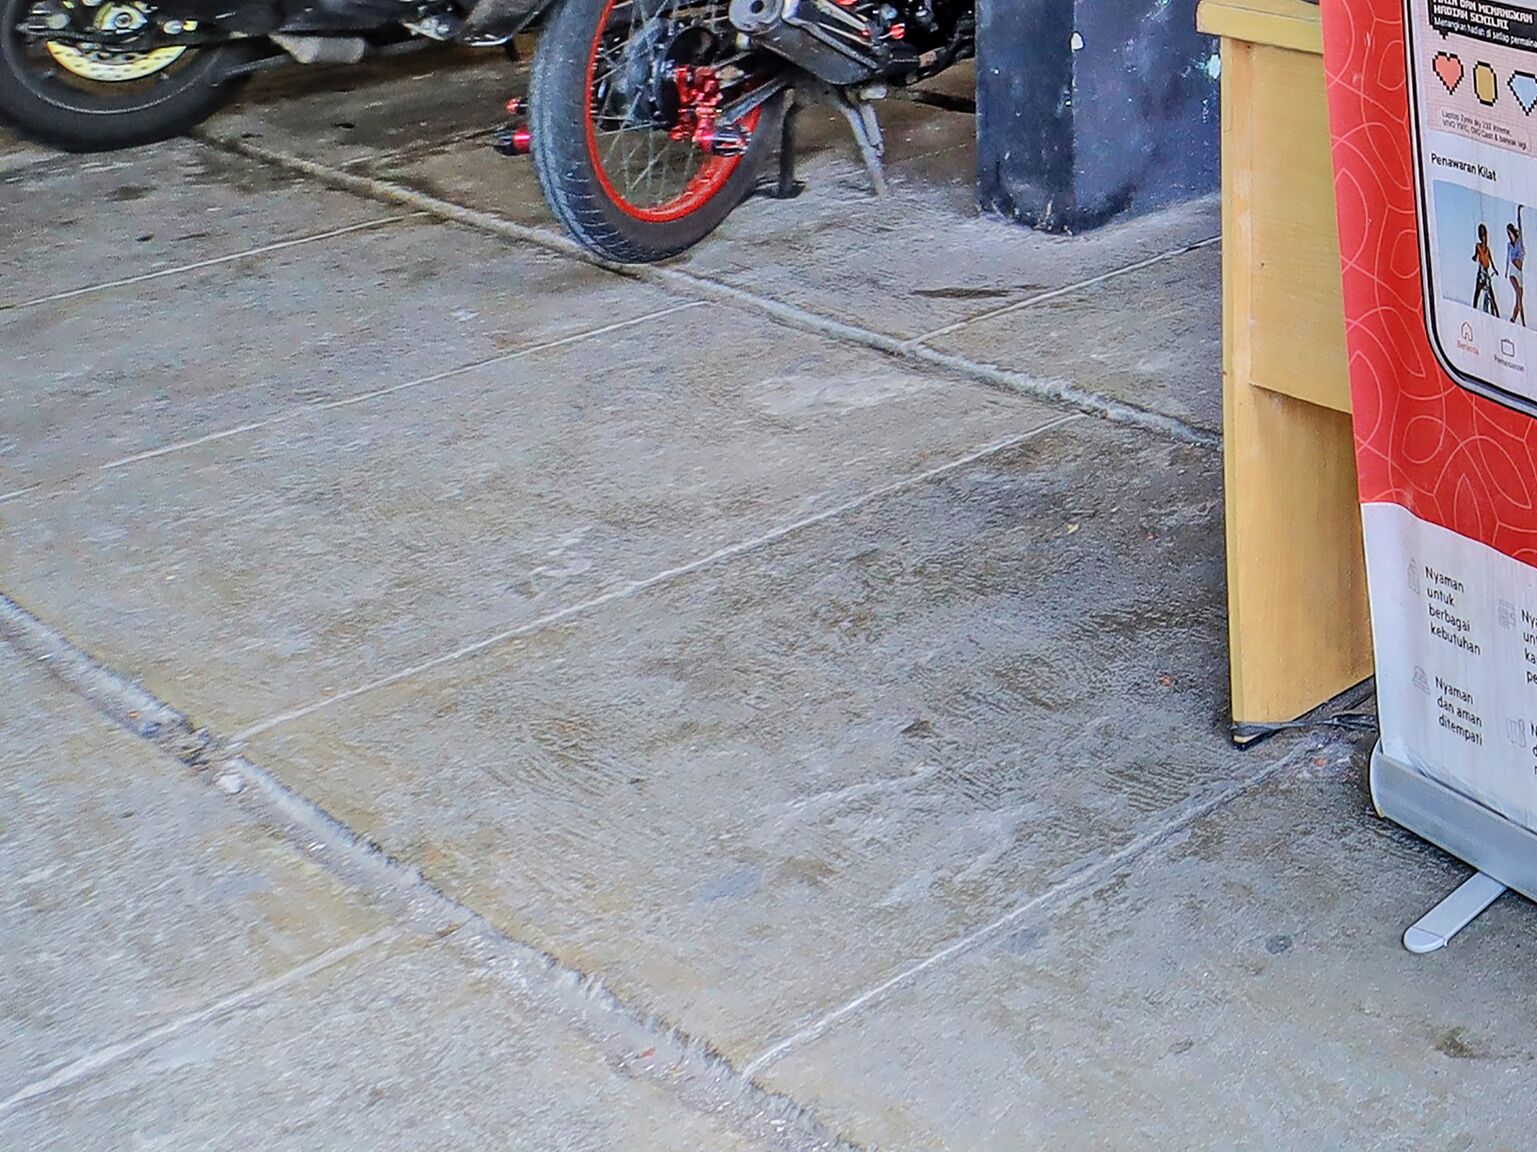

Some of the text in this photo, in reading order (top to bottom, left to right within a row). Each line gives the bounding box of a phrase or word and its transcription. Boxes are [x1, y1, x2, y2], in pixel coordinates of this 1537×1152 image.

[1433, 5, 1509, 30] HADIAH SENILAI
[1479, 3, 1533, 23] MENANGKAN
[1431, 153, 1496, 181] Penawaran Kilat
[1425, 566, 1464, 593] Nyaman
[1427, 588, 1454, 606] untuk
[1429, 603, 1470, 632] berbagai
[1431, 622, 1480, 655] kebutuhan
[1435, 676, 1473, 704] Nyaman
[1437, 696, 1482, 727] dan aman
[1439, 715, 1482, 745] ditempati
